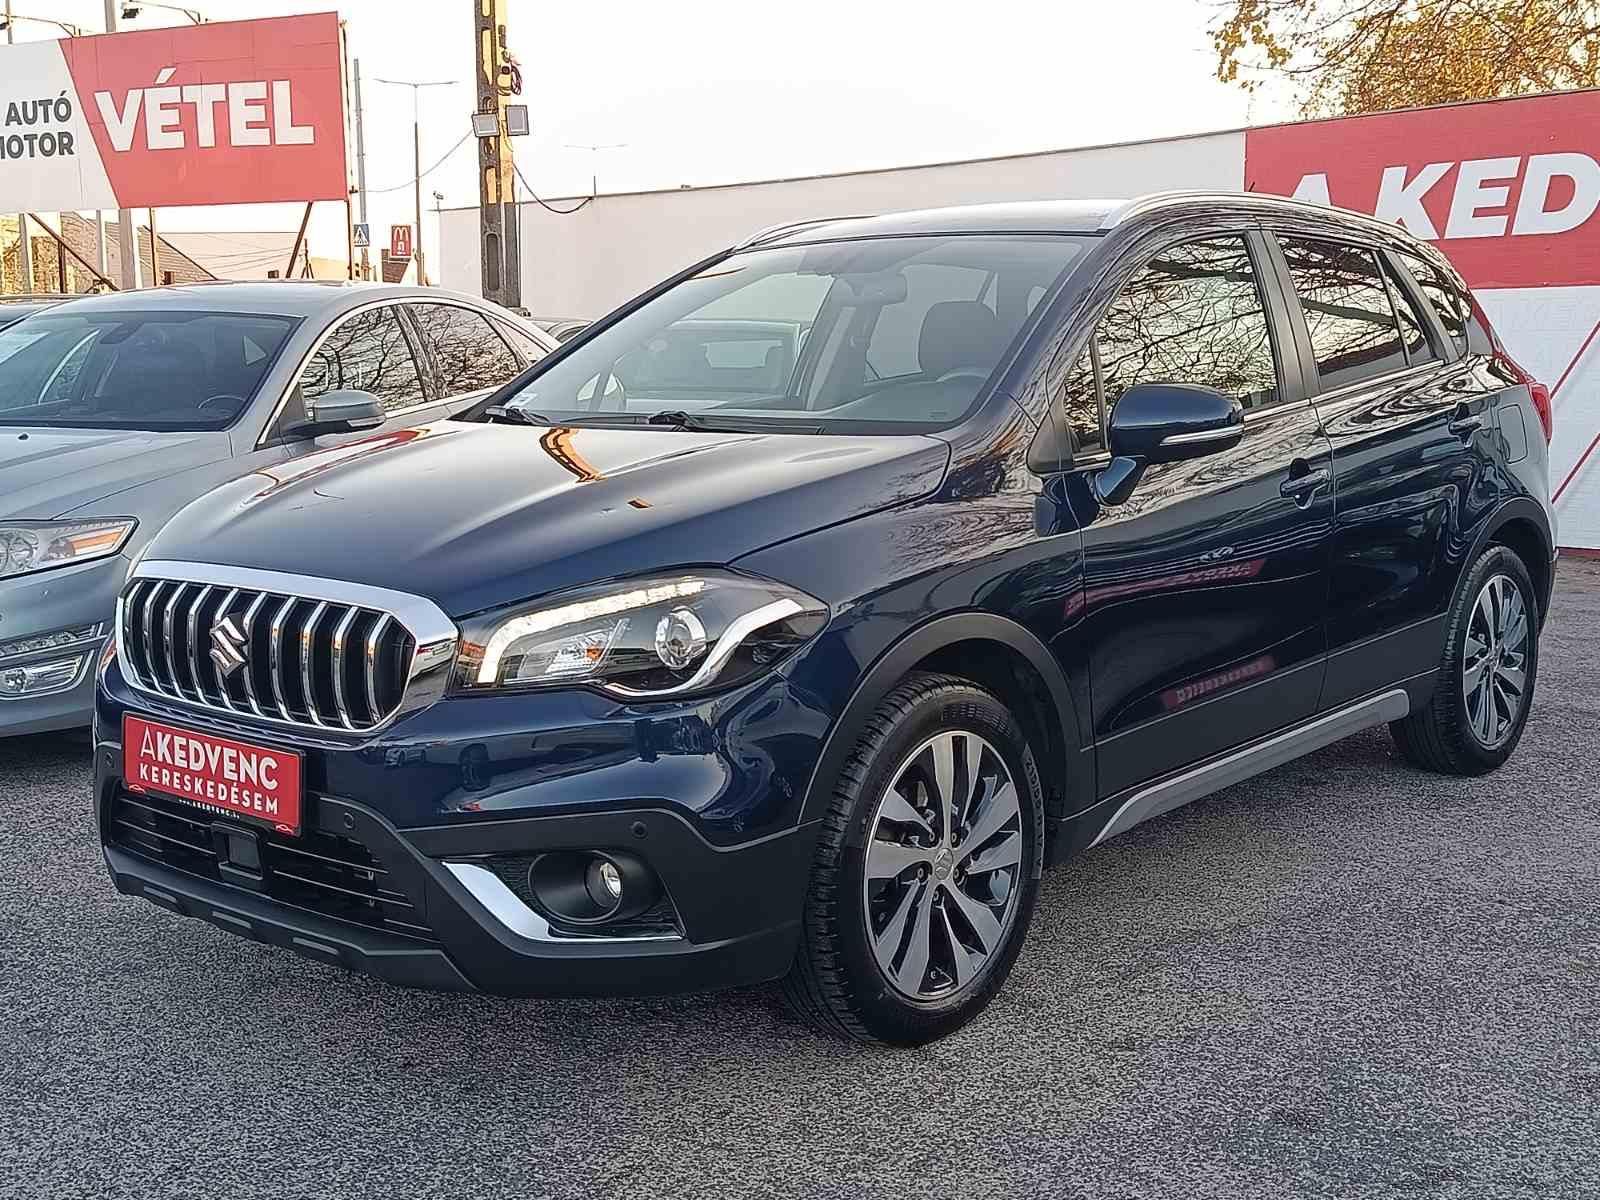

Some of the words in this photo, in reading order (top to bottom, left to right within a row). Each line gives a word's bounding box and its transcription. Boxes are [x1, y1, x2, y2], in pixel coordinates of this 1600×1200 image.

[5, 90, 72, 127] AUTÓ
[94, 67, 315, 152] VÉTEL
[138, 762, 279, 816] KERESKEDÉSEM
